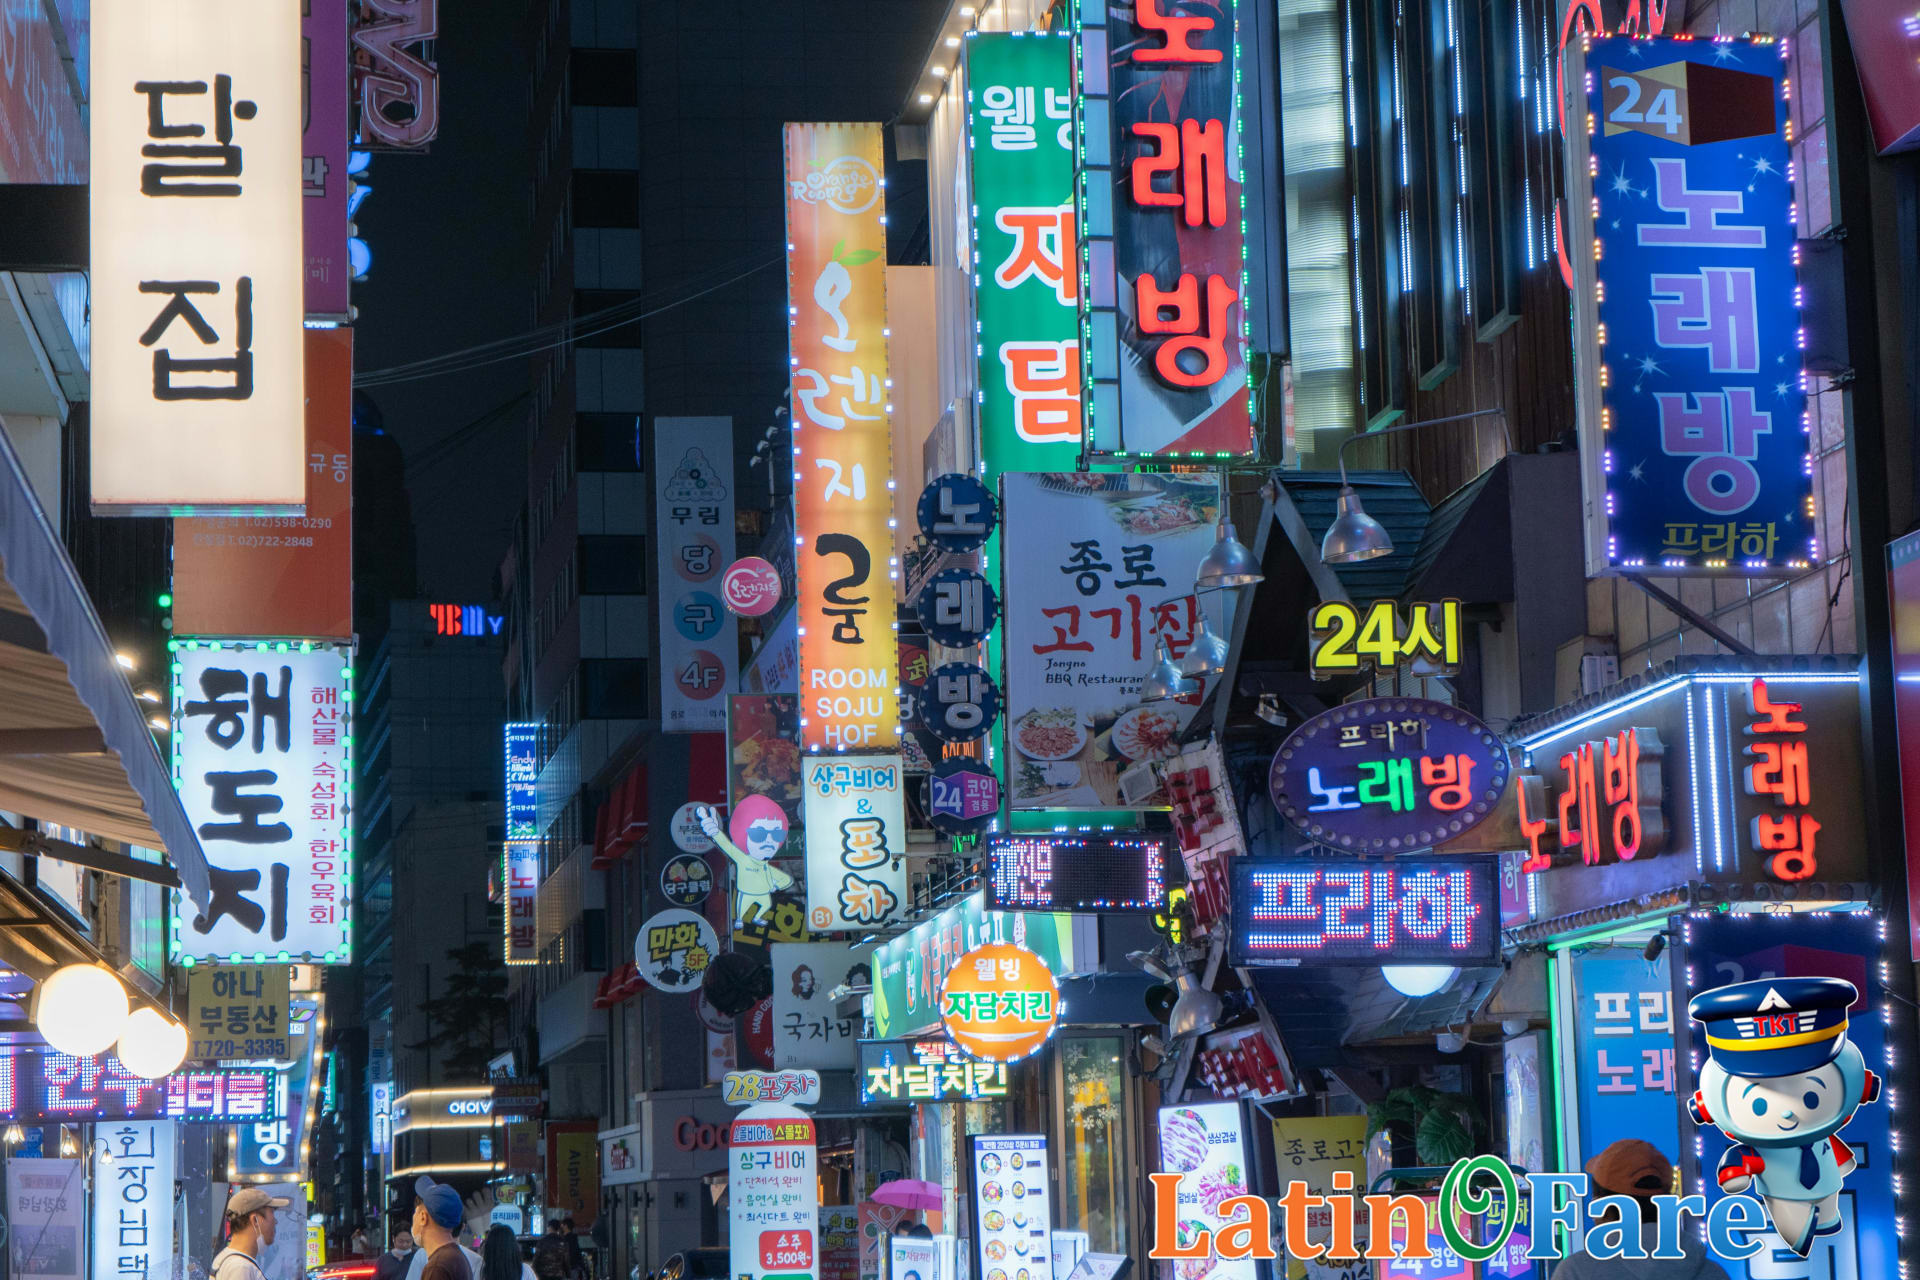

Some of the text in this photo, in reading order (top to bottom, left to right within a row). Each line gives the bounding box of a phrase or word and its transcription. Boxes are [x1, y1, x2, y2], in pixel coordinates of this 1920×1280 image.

[1608, 76, 1682, 135] 24
[1132, 0, 1238, 388] 노래방
[134, 73, 258, 401] 달집
[1637, 157, 1773, 516] 노래방
[671, 506, 720, 526] 무림
[1659, 521, 1780, 560] 프라하
[1060, 539, 1167, 597] 종로
[933, 487, 990, 730] 노래방
[1312, 599, 1461, 670] 24시
[679, 661, 720, 690] 4F
[811, 668, 888, 689] ROOM
[1046, 658, 1086, 671] Jongno
[1046, 673, 1147, 687] BBQ Restauran
[816, 696, 884, 717] SOJU
[825, 724, 878, 745] HOF
[1338, 718, 1432, 752] 프라하
[812, 764, 895, 794] 상구비어
[934, 778, 993, 813] 24 코인
[1307, 753, 1478, 812] 노래방
[1752, 677, 1822, 882] 노래방
[856, 798, 873, 815] &
[1516, 727, 1641, 874] 노래방
[839, 816, 898, 925] 포차
[510, 867, 536, 949] 노래방
[1248, 869, 1481, 950] 프라하
[648, 921, 699, 957] 만화
[688, 953, 706, 966] 5F
[973, 957, 1022, 982] 웰빙
[211, 969, 265, 999] 하나
[199, 1005, 278, 1035] 부동산
[945, 991, 1052, 1023] 자담치킨
[191, 1038, 286, 1058] T.720-3335
[724, 1073, 817, 1104] 28포차
[866, 1060, 1008, 1098] 자담치킨
[740, 1150, 806, 1170] 상구비어
[746, 1211, 790, 1224] 최신다트
